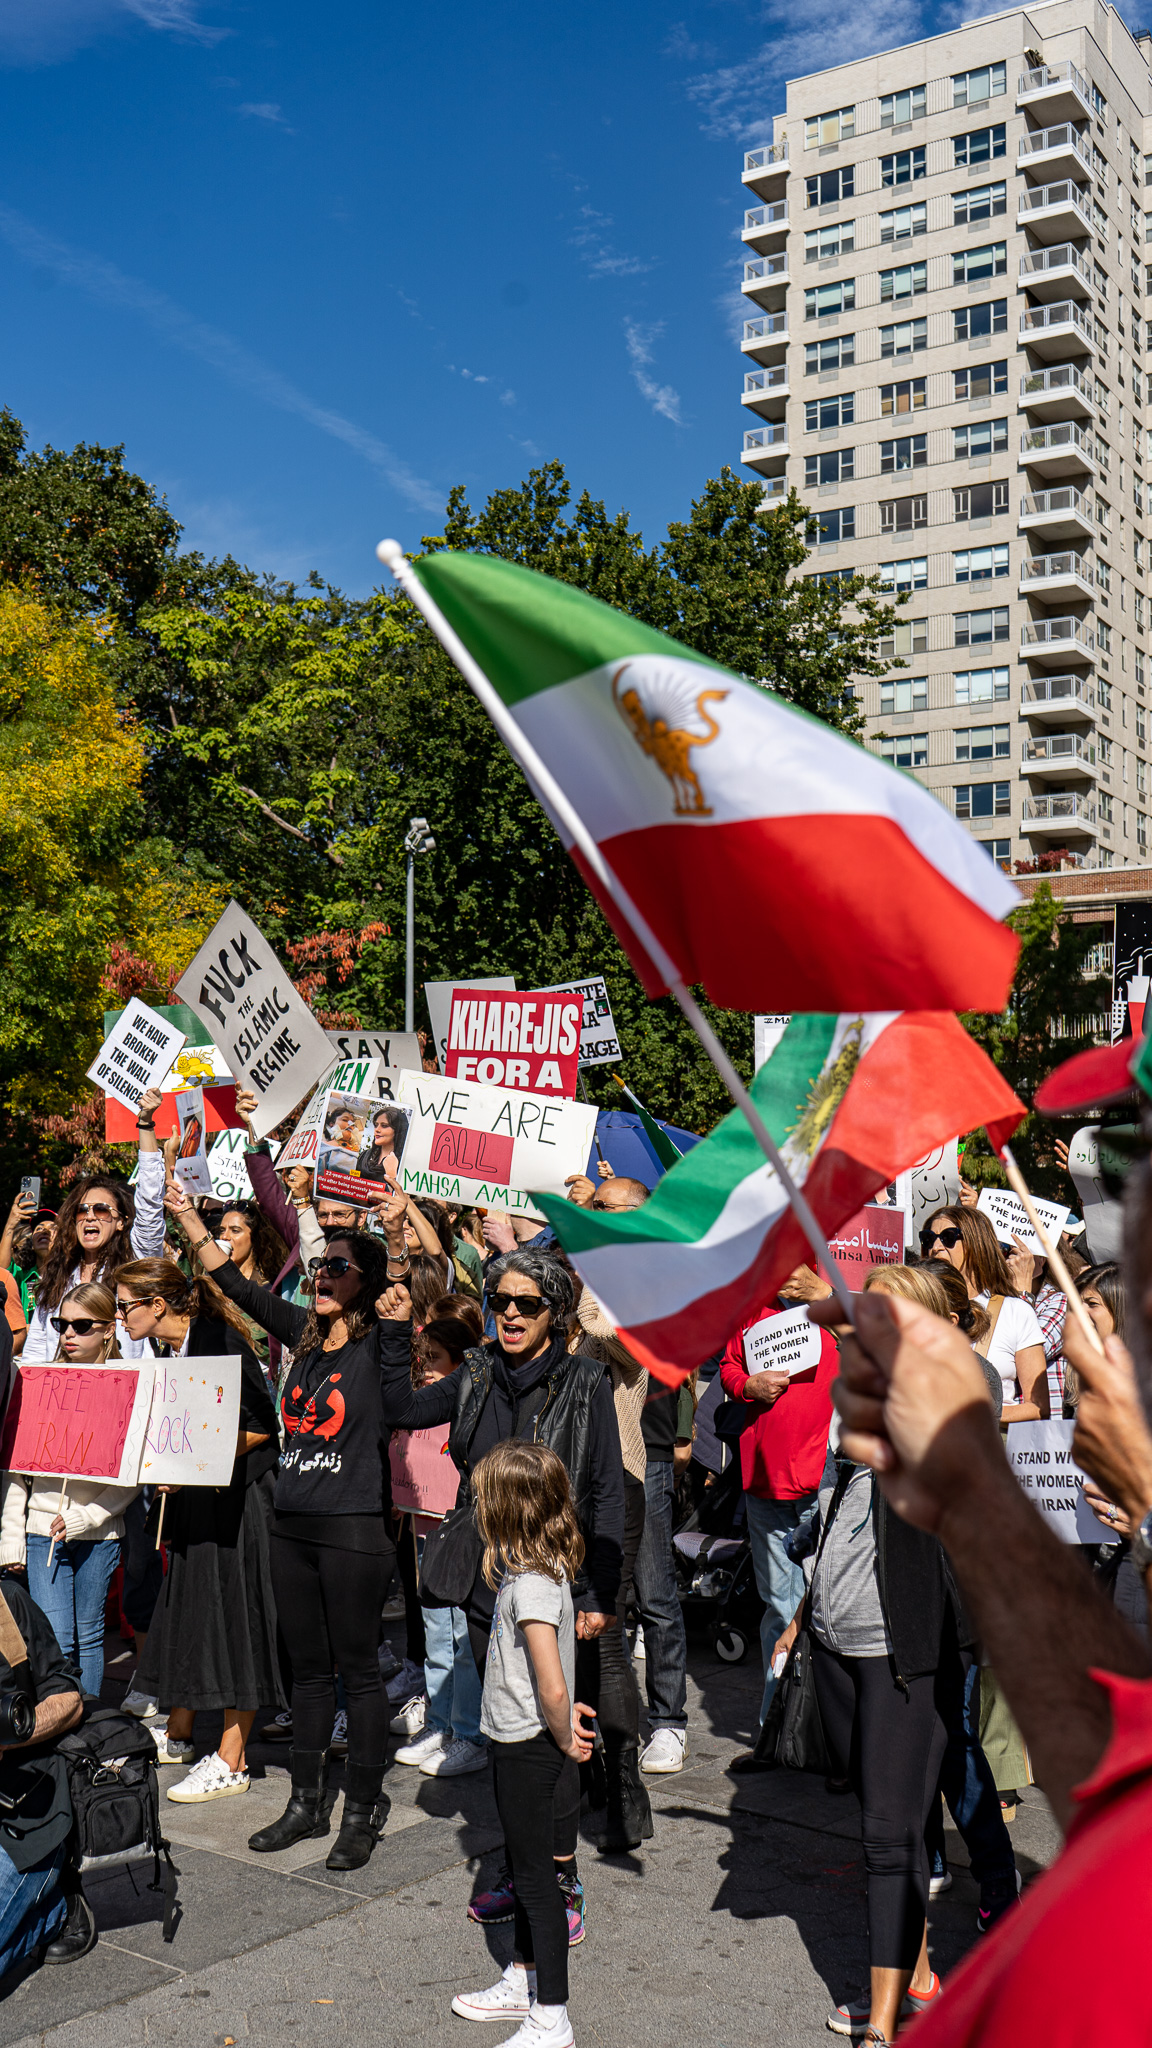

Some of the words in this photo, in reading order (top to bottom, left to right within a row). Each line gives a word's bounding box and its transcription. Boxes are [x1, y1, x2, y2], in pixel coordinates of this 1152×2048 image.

[199, 930, 262, 1029] FUCK
[237, 995, 255, 1019] THE
[131, 1013, 149, 1034] WE
[144, 1024, 170, 1050] HAVE
[233, 986, 290, 1067] ISLAMIC
[450, 1000, 580, 1056] KHAREJIS
[122, 1032, 159, 1066] BROKEN
[249, 1027, 301, 1093] REGIME
[96, 1062, 111, 1079] OF
[109, 1046, 129, 1068] THE
[126, 1059, 151, 1086] WALL
[456, 1057, 531, 1087] FOR
[534, 1061, 564, 1089] A
[416, 1088, 470, 1125] WE
[490, 1101, 563, 1146] ARE
[214, 1155, 248, 1174] STAN
[433, 1128, 498, 1174] ALL
[403, 1168, 461, 1198] MAHSA
[990, 1204, 1009, 1218] THE
[996, 1219, 1009, 1229] OF
[1011, 1227, 1036, 1237] IRAN
[830, 1249, 863, 1261] ahsa
[754, 1330, 783, 1348] STAND
[784, 1322, 811, 1336] WITH
[754, 1347, 770, 1361] THE
[771, 1335, 809, 1353] WOMEN
[763, 1359, 775, 1370] OF
[777, 1351, 801, 1365] IRAN
[39, 1376, 91, 1413] FREE
[34, 1422, 94, 1467] IRAN
[1017, 1451, 1051, 1464] STAND
[1054, 1451, 1072, 1464] WI
[299, 1452, 342, 1476] زندگی
[1016, 1474, 1033, 1487] HE
[1035, 1474, 1085, 1488] WOMEN
[1042, 1498, 1077, 1511] IRAN
